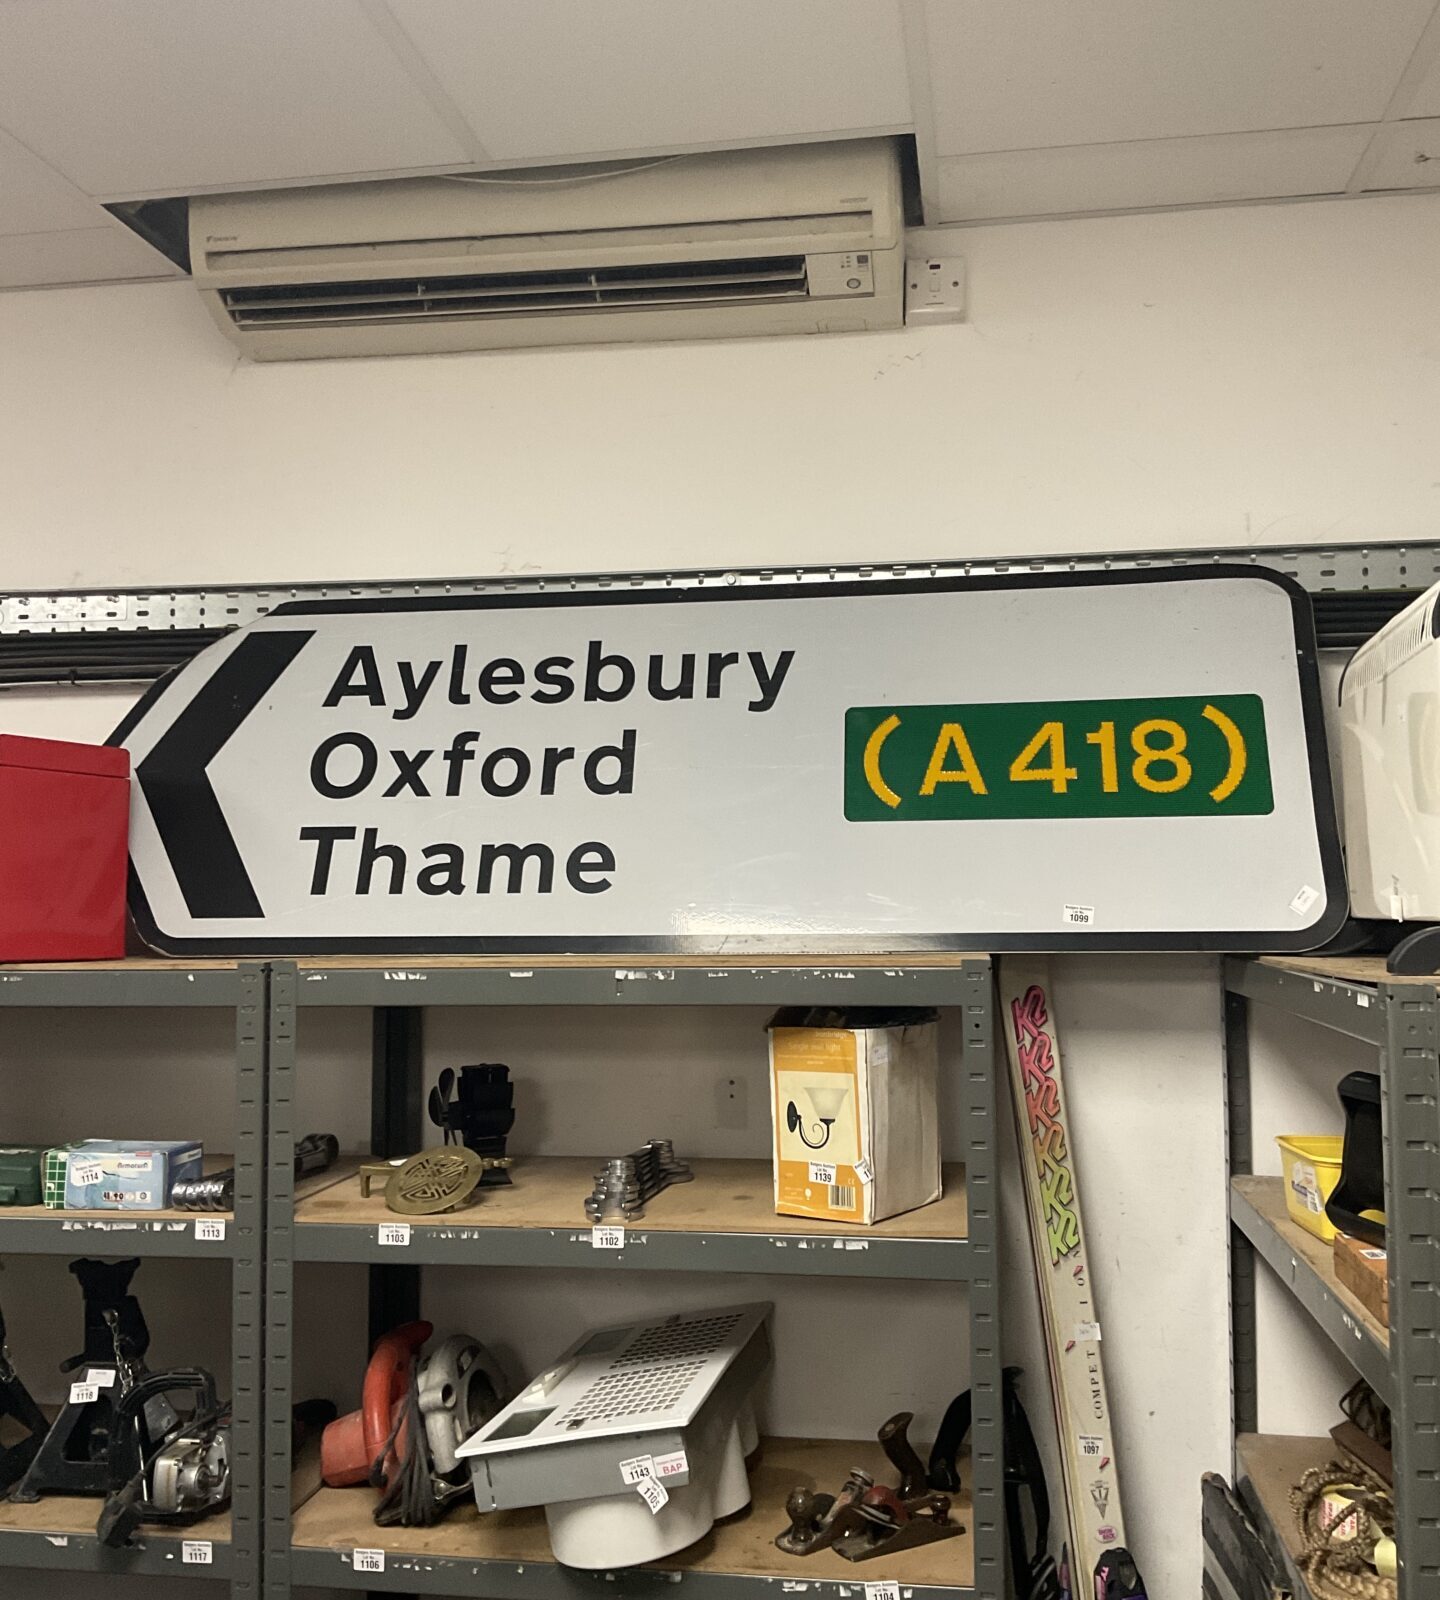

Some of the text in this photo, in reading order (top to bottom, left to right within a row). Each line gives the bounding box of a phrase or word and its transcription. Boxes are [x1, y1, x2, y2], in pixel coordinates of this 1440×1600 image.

[321, 640, 796, 721] Aylesbury
[309, 729, 638, 799] Oxford
[298, 825, 617, 896] Thame
[1070, 913, 1089, 923] 1099
[81, 1172, 98, 1183] 1114
[814, 1172, 832, 1183] 1139
[202, 1229, 220, 1238] 1113
[386, 1233, 405, 1243] 1103
[599, 1236, 619, 1246] 1102
[76, 1391, 94, 1401] 1118
[1083, 1445, 1100, 1455] 1097
[662, 1462, 683, 1475] BAP
[629, 1467, 650, 1481] 1143
[189, 1552, 207, 1561] 1117
[360, 1559, 380, 1569] 1106
